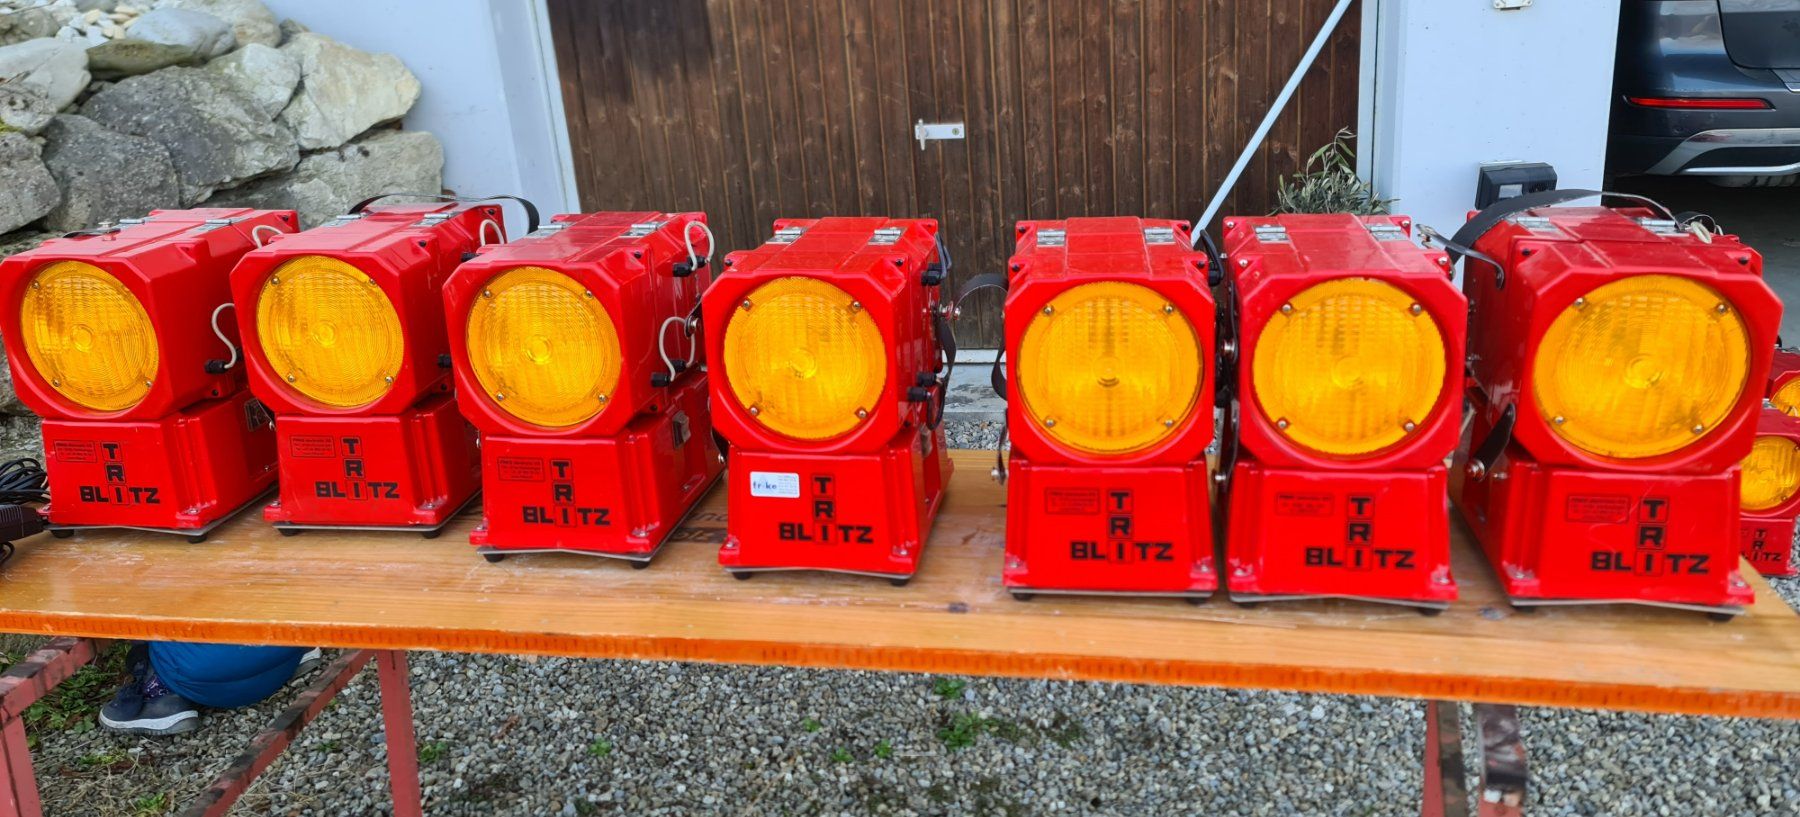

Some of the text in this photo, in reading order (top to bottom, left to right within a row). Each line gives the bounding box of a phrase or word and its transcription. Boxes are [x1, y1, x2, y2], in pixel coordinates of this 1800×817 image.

[79, 485, 160, 504] BLITZ
[315, 481, 400, 499] BLITZ
[522, 506, 610, 526] BLITZ
[779, 522, 873, 543] BLITZ
[1071, 541, 1173, 561] BLITZ
[1305, 547, 1414, 569] BLITZ
[1591, 551, 1709, 574] BLITZ
